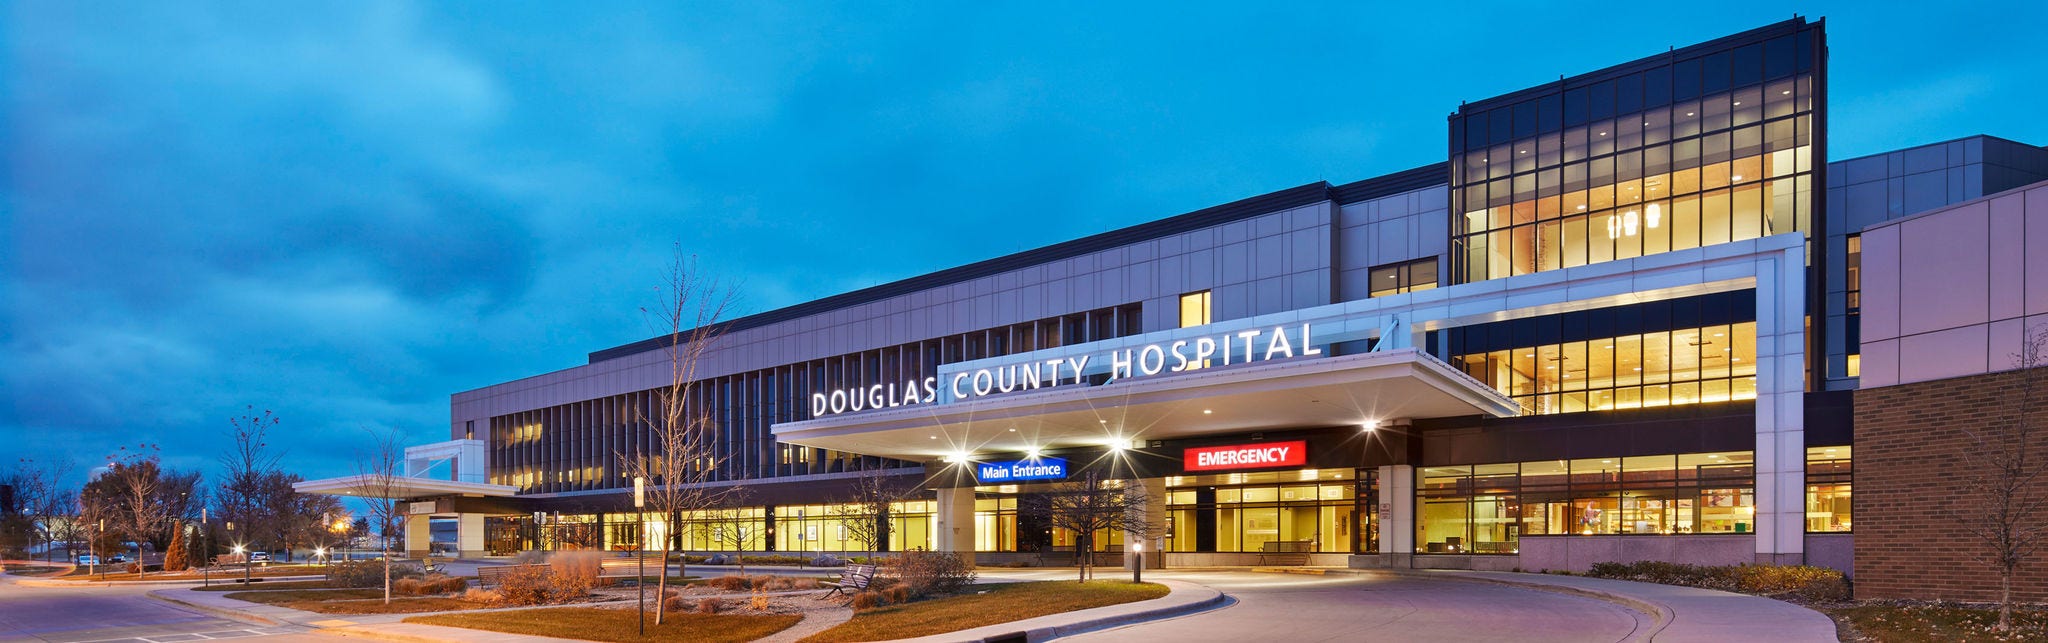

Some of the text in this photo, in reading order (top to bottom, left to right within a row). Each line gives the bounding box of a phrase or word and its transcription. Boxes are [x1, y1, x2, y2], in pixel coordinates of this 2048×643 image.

[812, 323, 1322, 417] DOUGLAS COUNTY HOSPITAL
[1197, 447, 1289, 467] EMERGENCY
[982, 464, 1061, 479] Main Entrance
